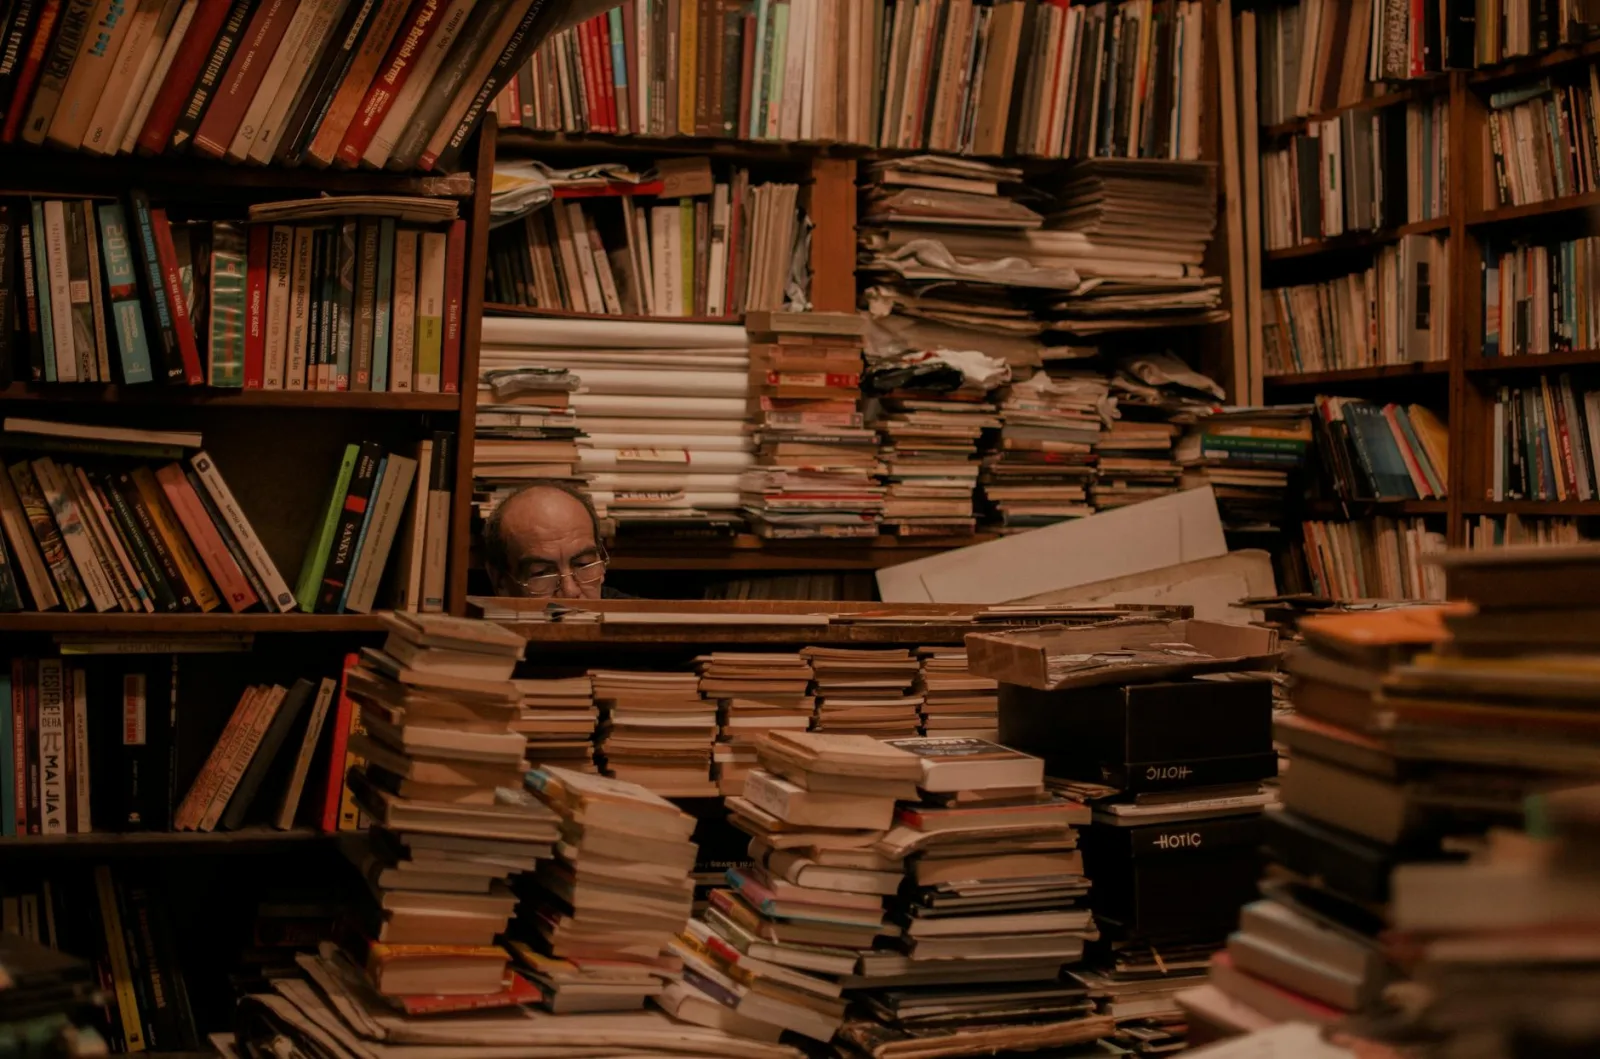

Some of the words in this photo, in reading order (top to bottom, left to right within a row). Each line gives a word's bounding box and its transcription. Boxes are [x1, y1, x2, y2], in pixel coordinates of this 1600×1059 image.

[414, 7, 433, 29] The
[444, 6, 465, 34] Allianz
[398, 25, 423, 59] British
[199, 34, 234, 86] ADVERTISING
[383, 56, 406, 86] Army
[184, 88, 208, 120] ANNUAL
[464, 75, 497, 124] ALMANAK
[449, 123, 468, 148] 2013
[21, 236, 31, 257] VAGINA
[105, 223, 129, 276] 2013
[277, 233, 288, 287] JACQUELINE
[298, 235, 308, 281] JACQUELINE
[23, 258, 35, 297] MONOLOGUES
[333, 522, 355, 566] SANKYA
[44, 755, 58, 785] MAI
[45, 789, 59, 814] JIA
